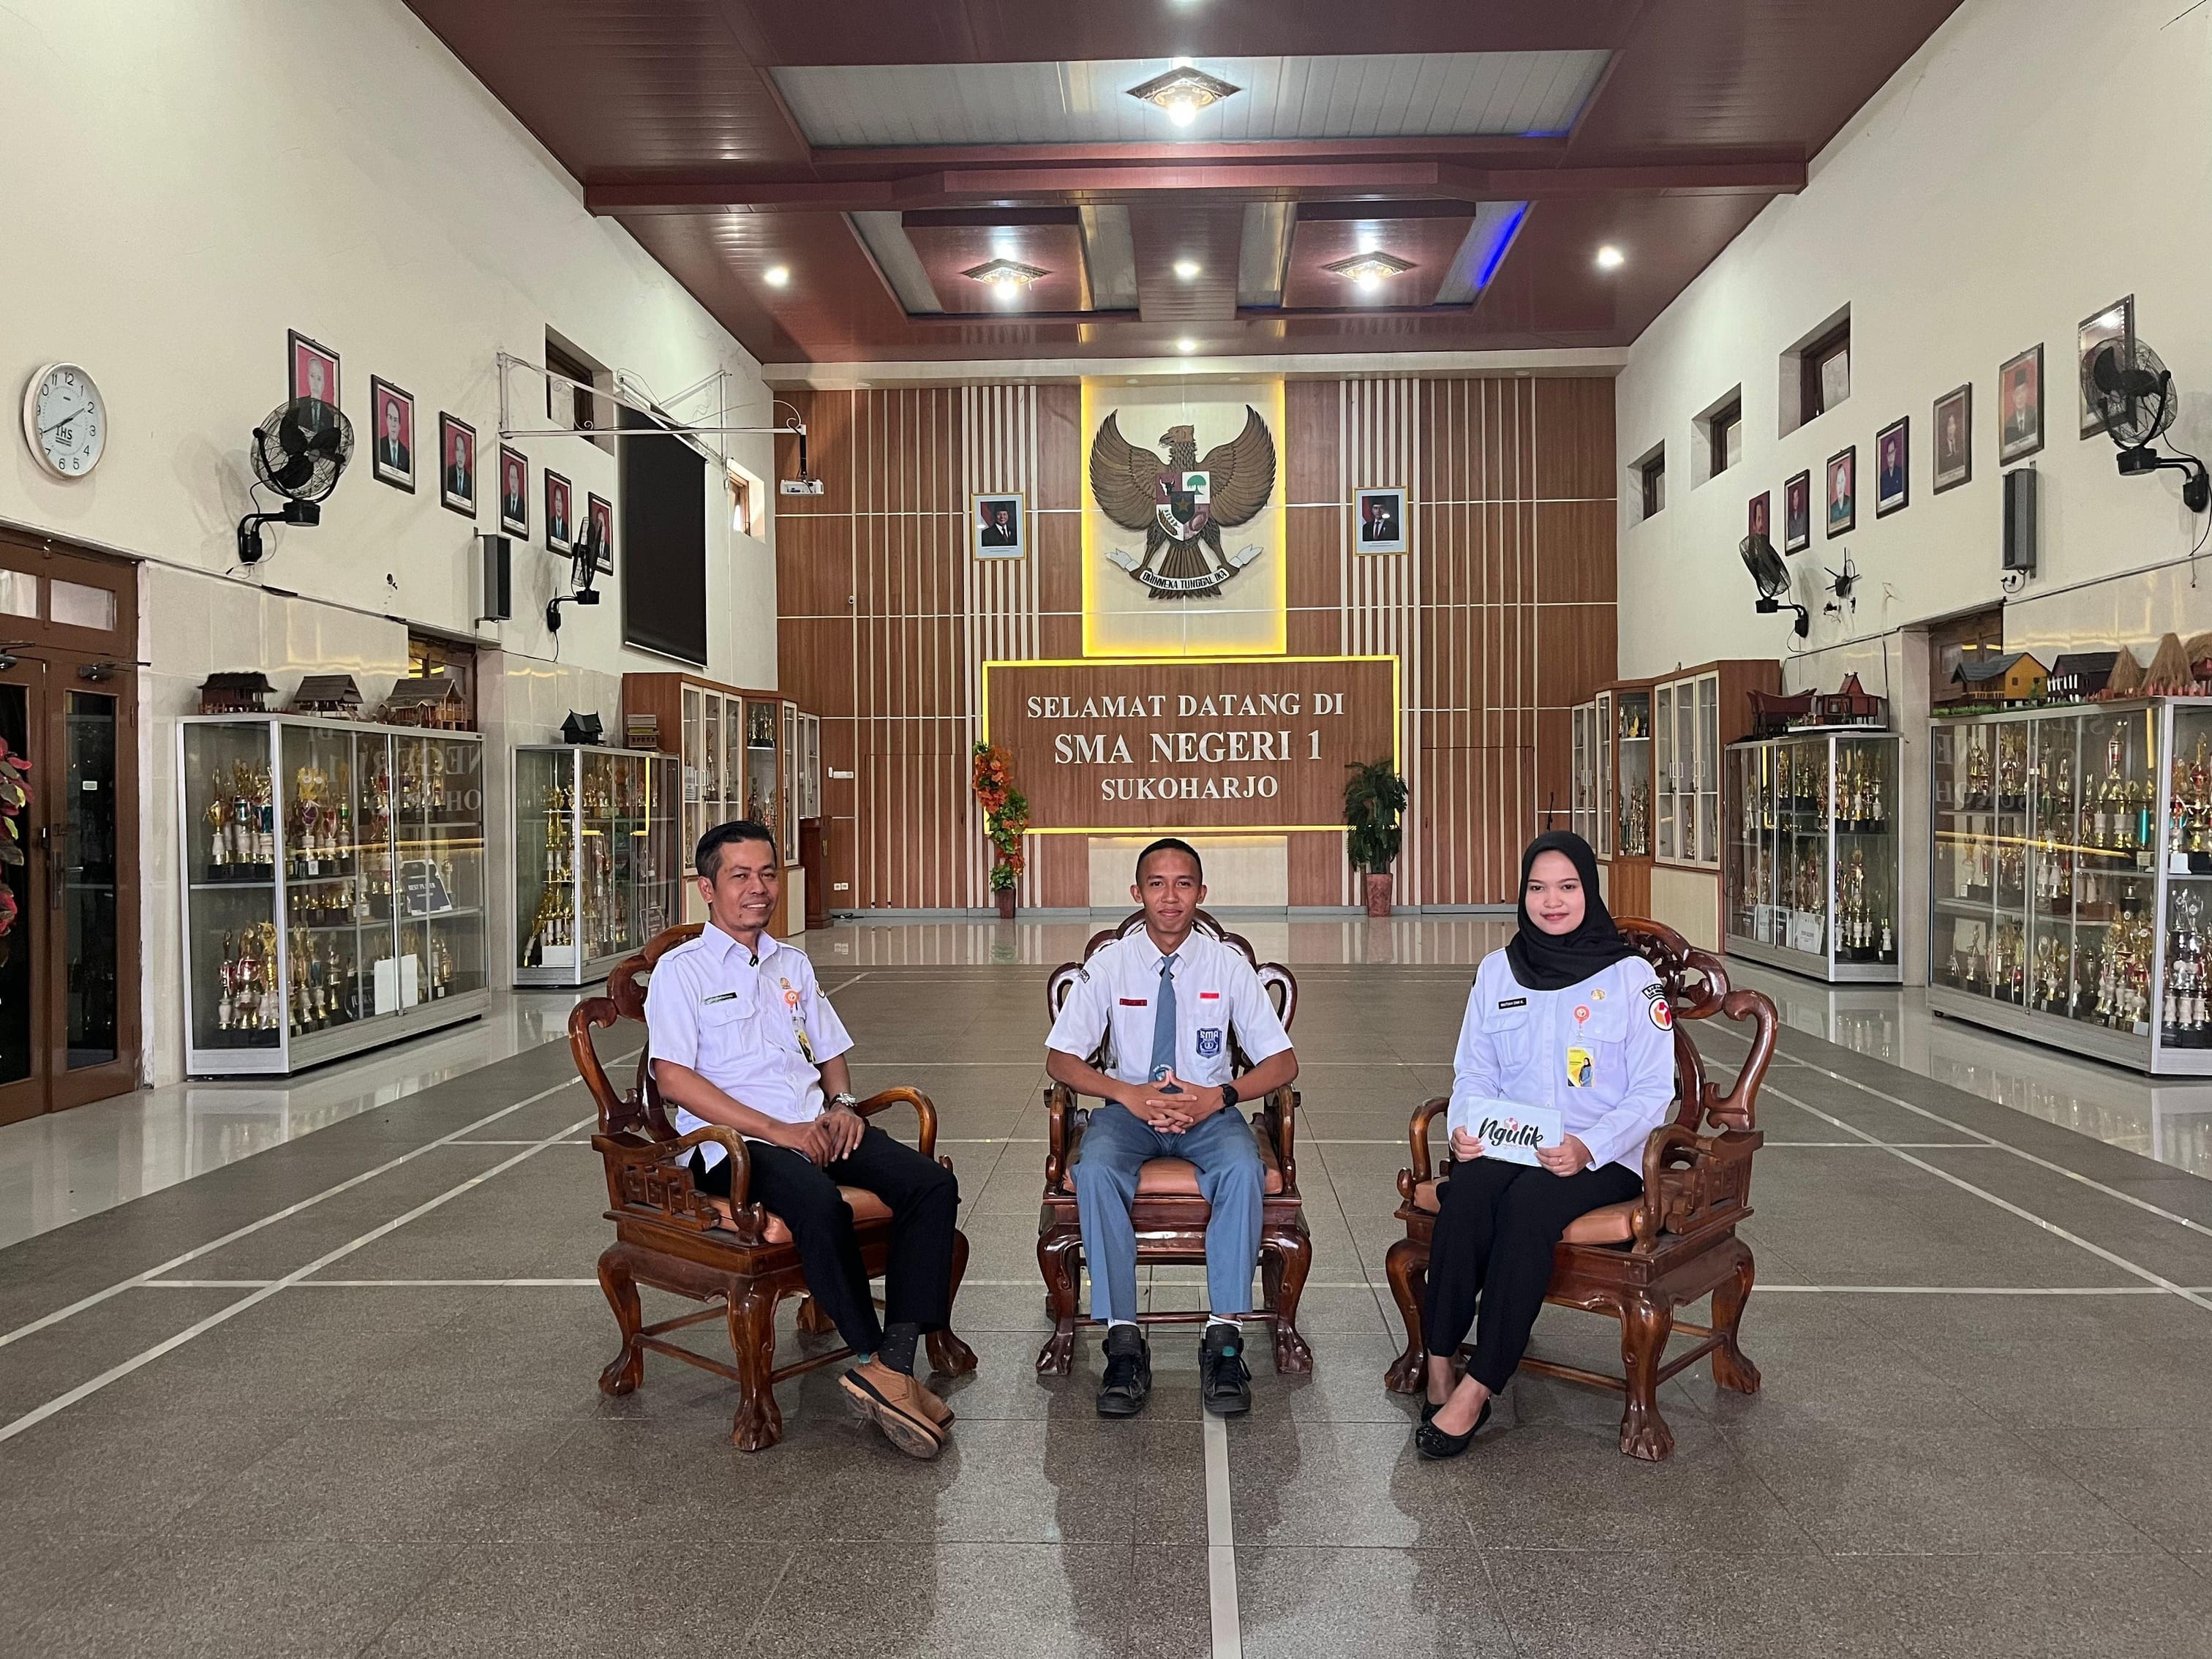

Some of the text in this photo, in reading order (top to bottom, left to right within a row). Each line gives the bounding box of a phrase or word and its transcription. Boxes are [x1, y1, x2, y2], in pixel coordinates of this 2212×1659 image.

[51, 373, 58, 386] 11
[64, 372, 75, 386] 12
[42, 383, 49, 396] 0
[87, 402, 94, 414] 2
[89, 424, 96, 437] 3
[83, 445, 90, 456] 4
[59, 457, 66, 470] 6
[72, 457, 80, 470] 5
[1181, 576, 1214, 589] TUNGGAL
[1214, 571, 1227, 582] IKA
[1027, 693, 1344, 718] SELAMAT DATANG DI
[1054, 729, 1323, 764] SMA NEGERI 1
[1101, 775, 1278, 801] SUKOHARJO
